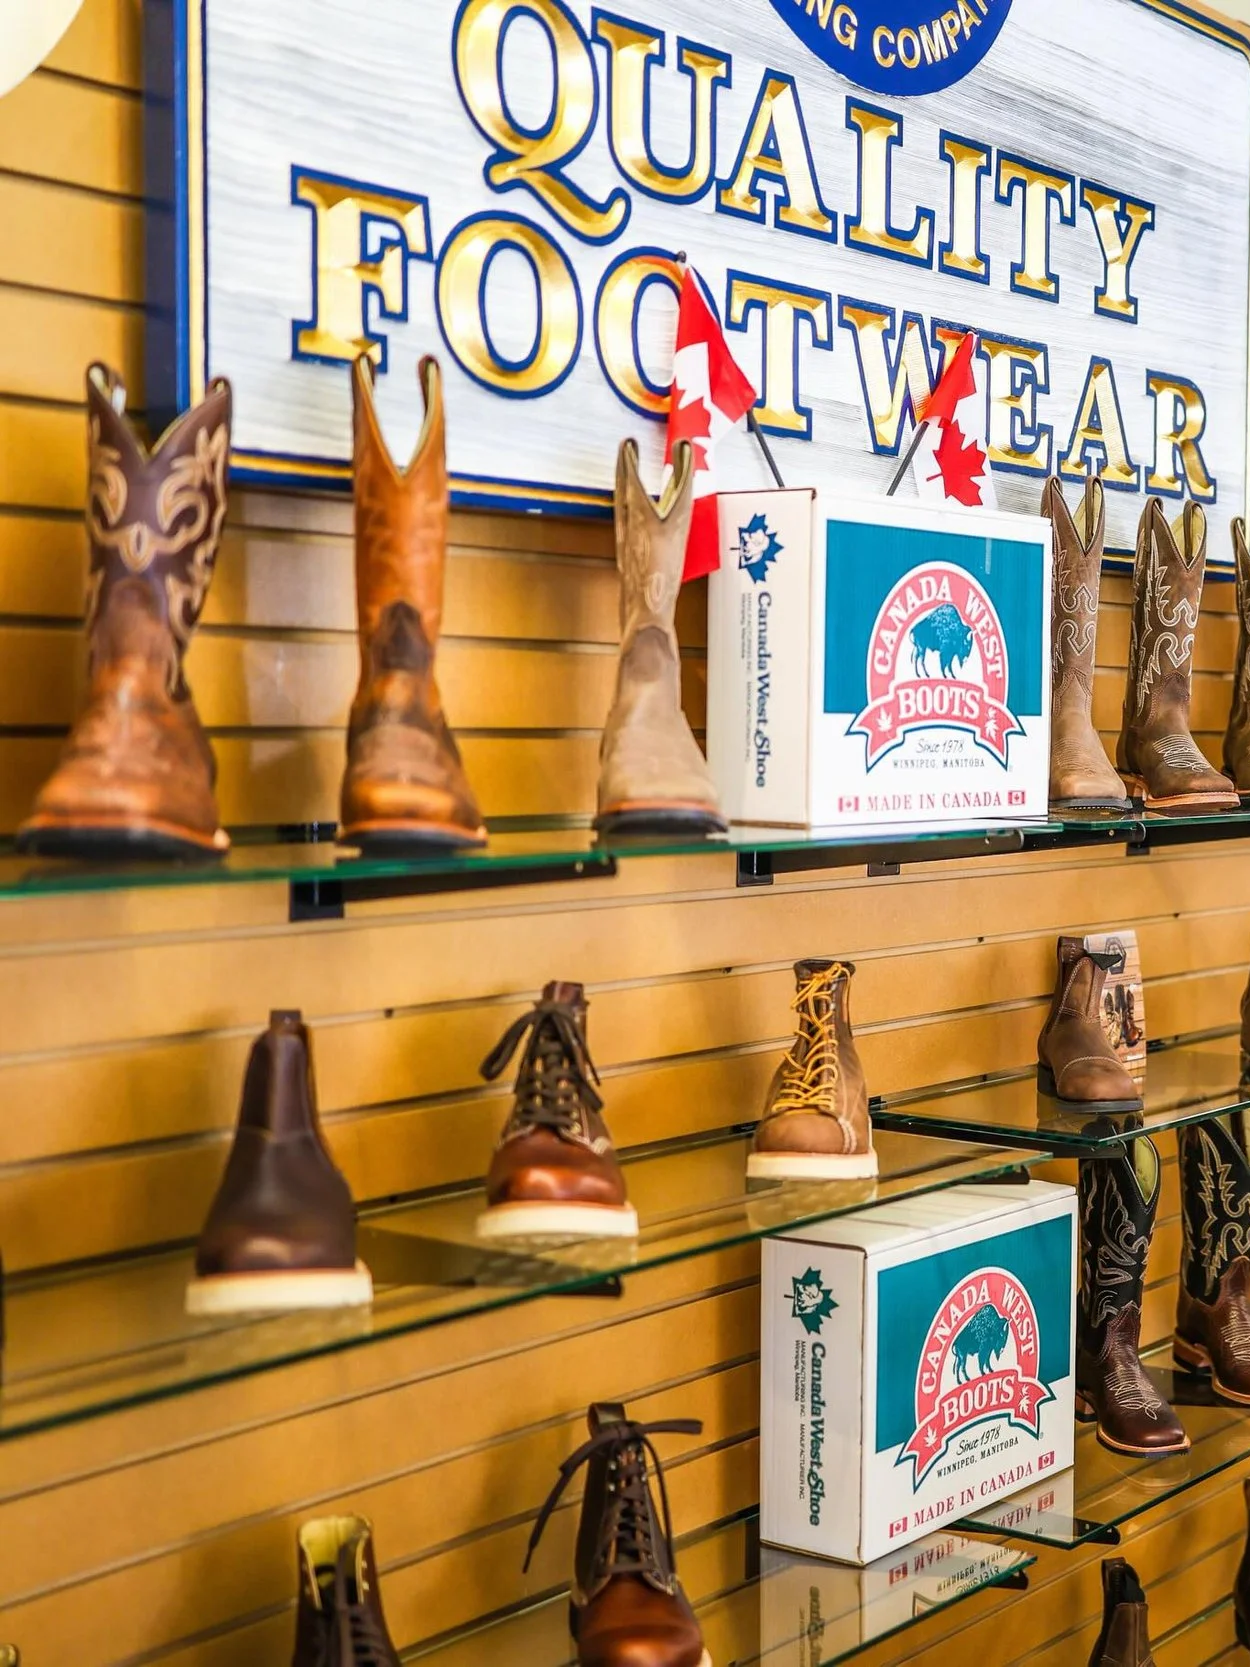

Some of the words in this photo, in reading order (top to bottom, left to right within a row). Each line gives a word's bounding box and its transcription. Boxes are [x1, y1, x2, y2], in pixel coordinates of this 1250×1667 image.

[796, 0, 858, 50] NG
[452, 0, 1155, 324] QUALITY
[290, 165, 1217, 504] FOOTWEAR
[757, 591, 771, 671] Canada
[873, 576, 953, 675] CANADA
[965, 588, 1003, 679] WEST
[757, 673, 770, 727] West
[897, 685, 981, 719] BOOTS
[754, 728, 771, 788] Shoe
[916, 738, 940, 754] Since
[941, 739, 964, 754] 1978
[943, 758, 985, 768] MANITOBA
[867, 795, 912, 811] MADE
[919, 793, 936, 809] IN
[942, 791, 1002, 808] CANADA
[921, 1279, 991, 1395] CANADA
[1002, 1282, 1035, 1356] WEST
[811, 1342, 826, 1417] Canada
[942, 1375, 1016, 1429] BOOTS
[811, 1418, 824, 1469] West
[936, 1455, 977, 1478] WINNIPEG,
[980, 1436, 1019, 1460] MANITOBA
[956, 1438, 980, 1456] Since
[980, 1424, 1002, 1447] 1978
[807, 1467, 826, 1526] Shoe
[913, 1496, 954, 1527] MADE
[960, 1486, 976, 1506] IN
[980, 1461, 1033, 1497] CANADA
